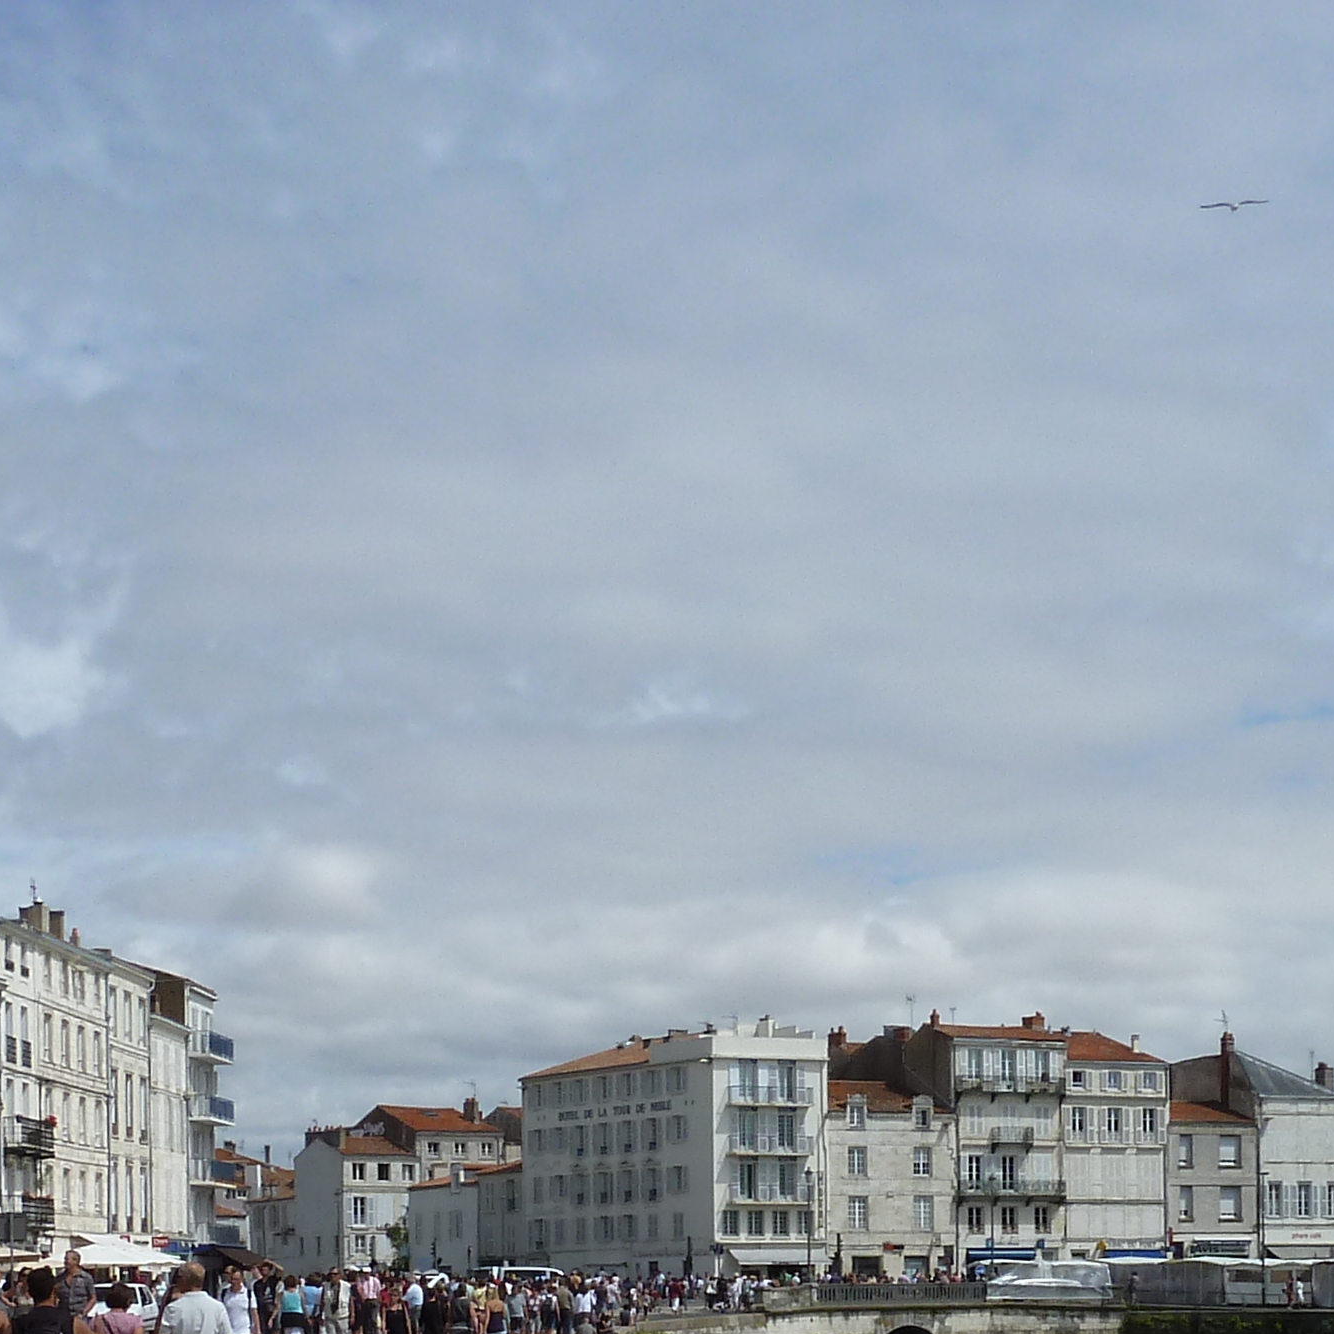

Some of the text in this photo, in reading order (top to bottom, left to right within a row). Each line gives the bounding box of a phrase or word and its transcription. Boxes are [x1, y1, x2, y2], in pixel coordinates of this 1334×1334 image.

[585, 1109, 593, 1119] DE
[598, 1107, 607, 1118] LA
[636, 1103, 646, 1114] DE
